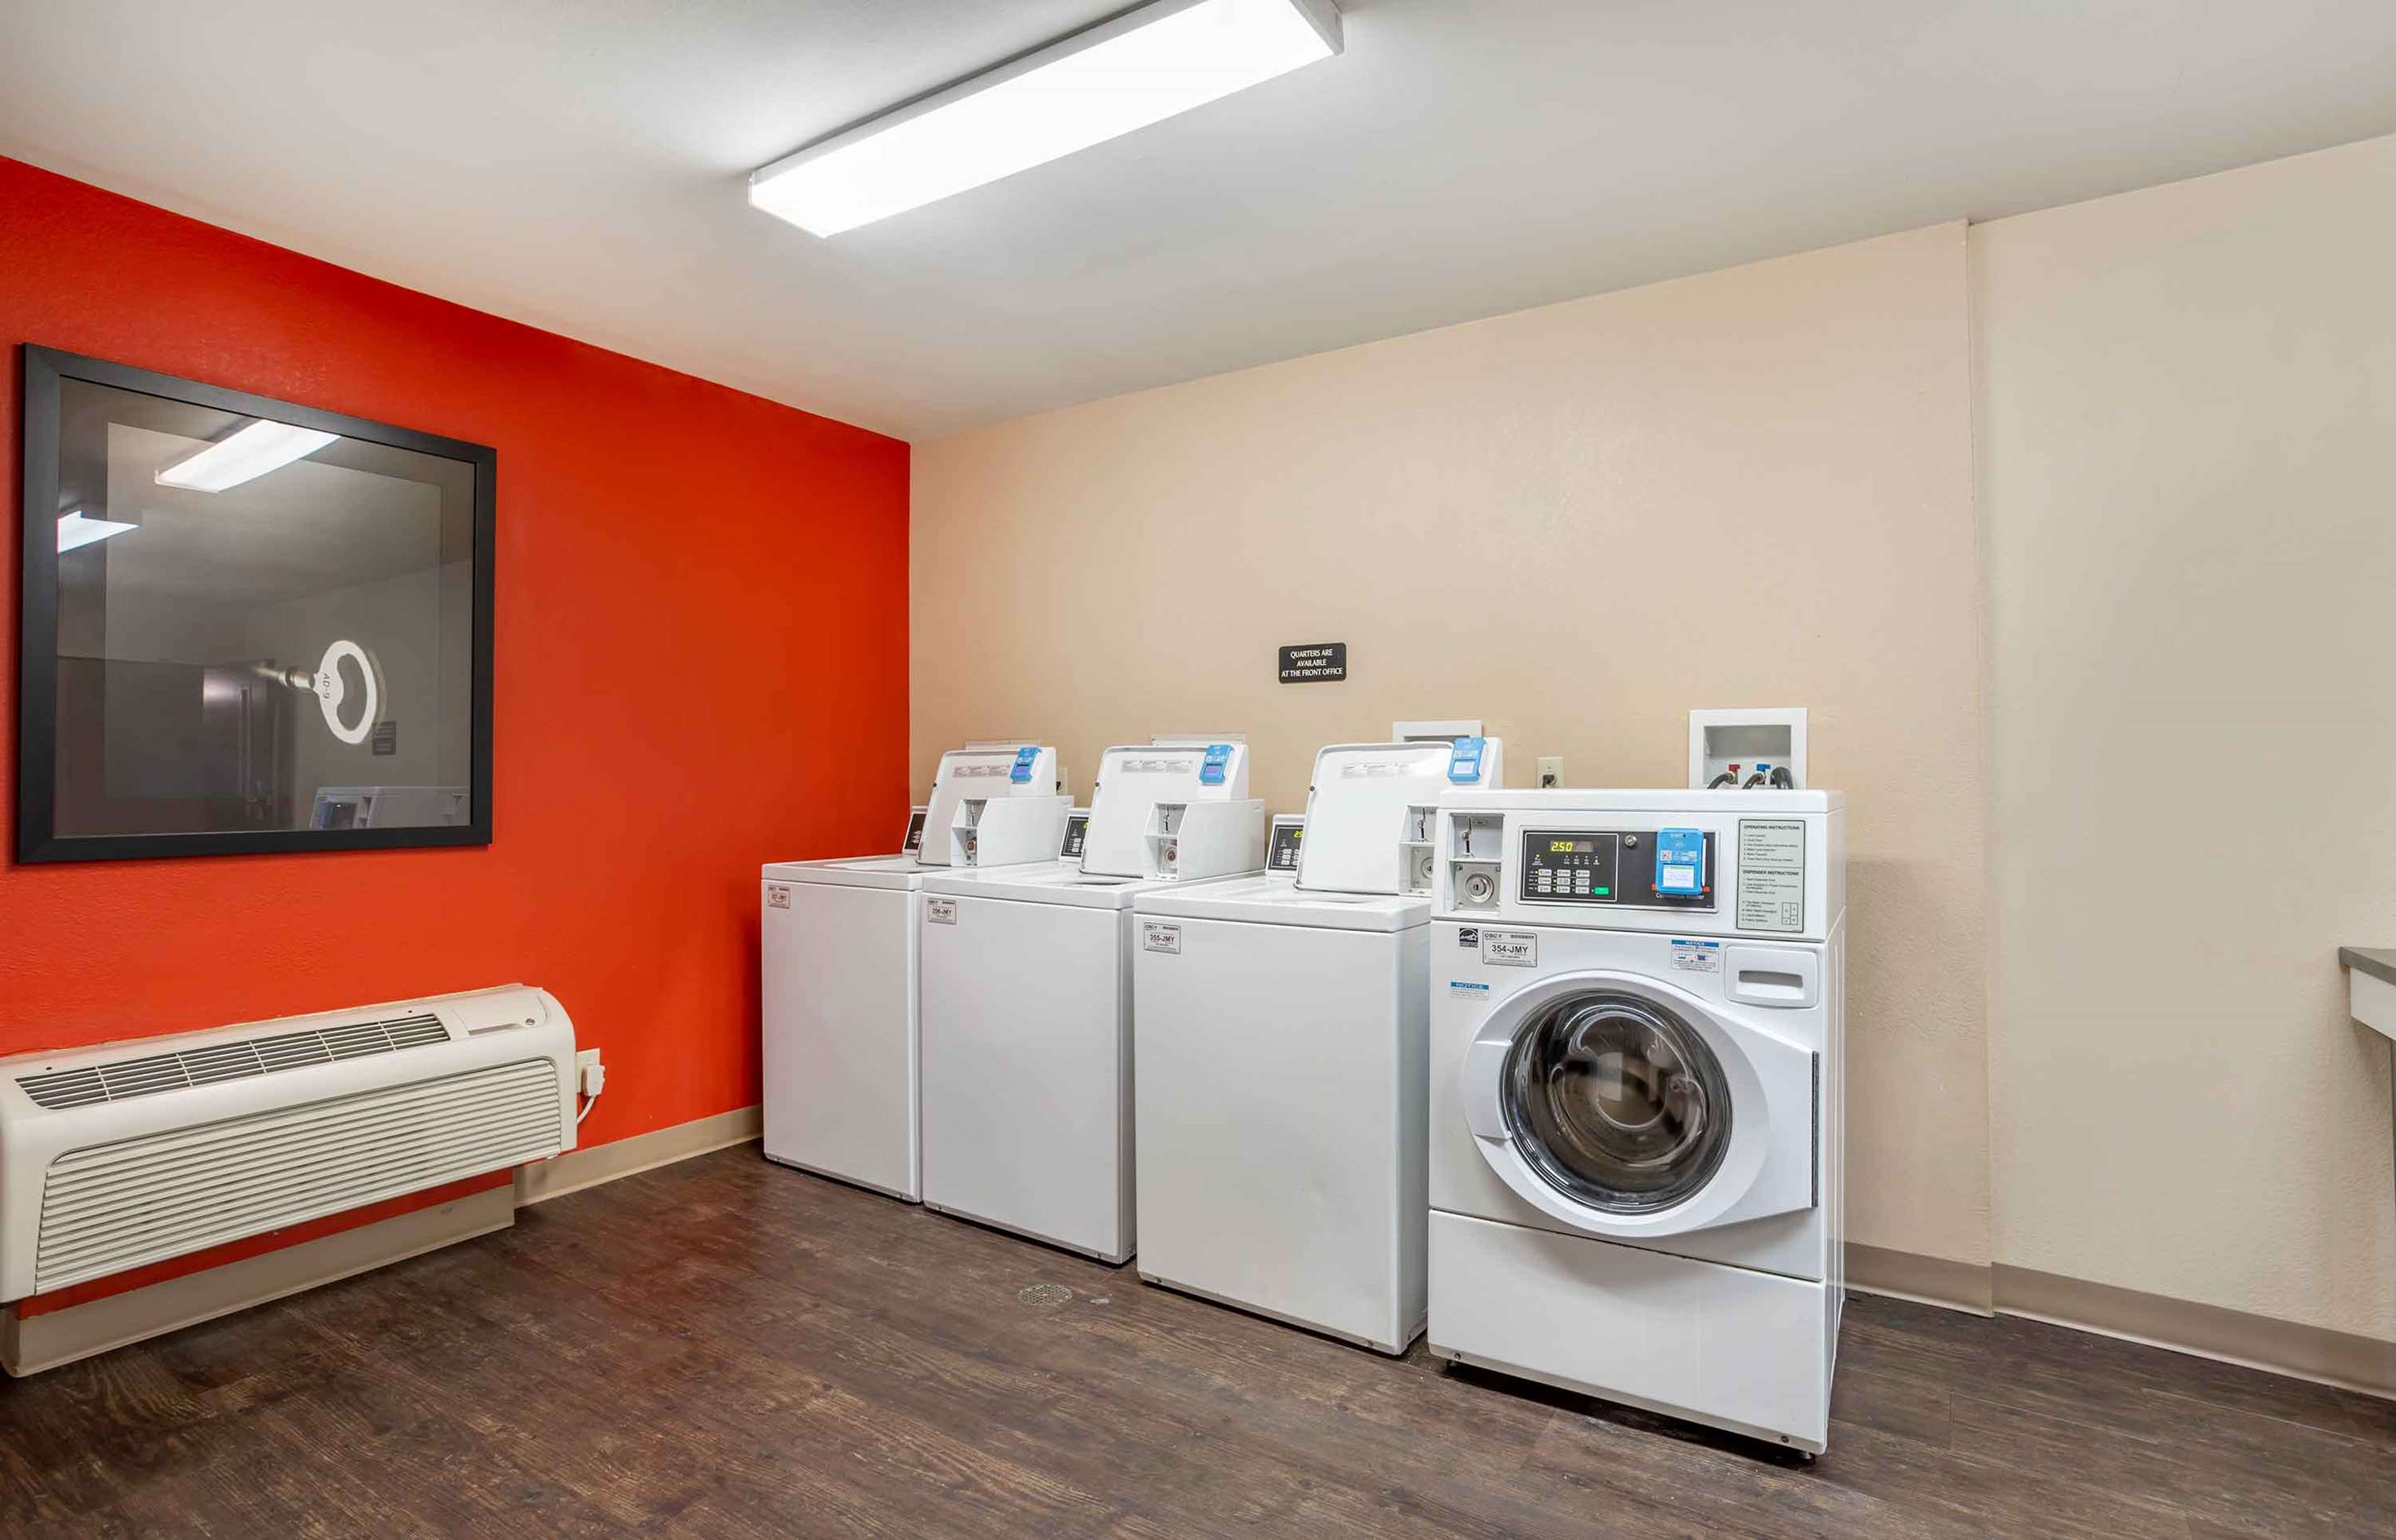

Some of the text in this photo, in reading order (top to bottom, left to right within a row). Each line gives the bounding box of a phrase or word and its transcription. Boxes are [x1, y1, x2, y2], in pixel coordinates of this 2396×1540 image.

[1290, 651, 1321, 659] QUARTERS
[1296, 659, 1327, 667] AVAILABLE
[1302, 668, 1322, 676] FRONT
[1322, 667, 1342, 676] OFFICE
[1550, 841, 1573, 852] 2.50
[1149, 933, 1175, 943] 355-JMY
[1491, 944, 1529, 953] 354-JMY
